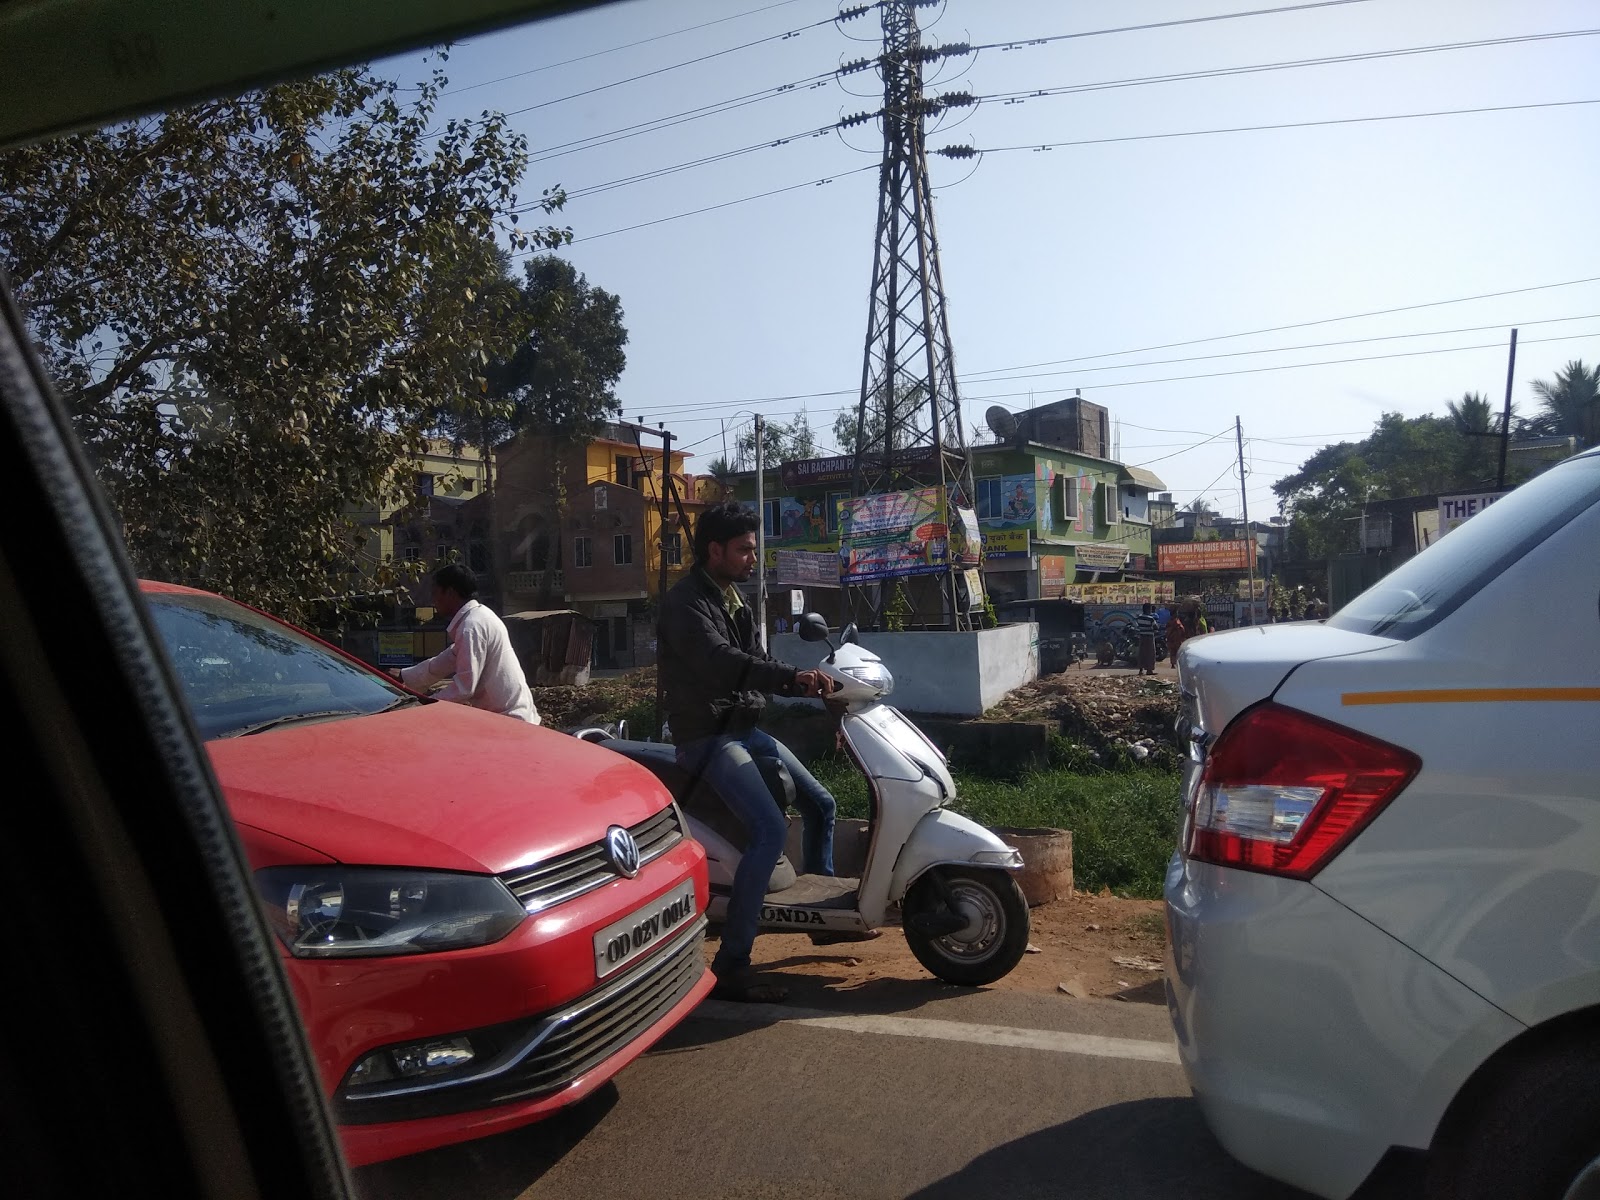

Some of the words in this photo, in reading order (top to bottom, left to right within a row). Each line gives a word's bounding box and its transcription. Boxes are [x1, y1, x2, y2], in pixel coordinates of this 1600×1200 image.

[798, 462, 809, 475] SAI
[811, 460, 845, 473] BACHPAN
[1443, 499, 1477, 518] THE
[1169, 543, 1193, 554] BACHPAN
[1194, 542, 1219, 553] PARADISE
[1220, 541, 1231, 551] PRE
[758, 906, 826, 924] ONDA
[607, 932, 631, 963] OD
[632, 912, 660, 948] 02V
[662, 893, 691, 929] 0014
